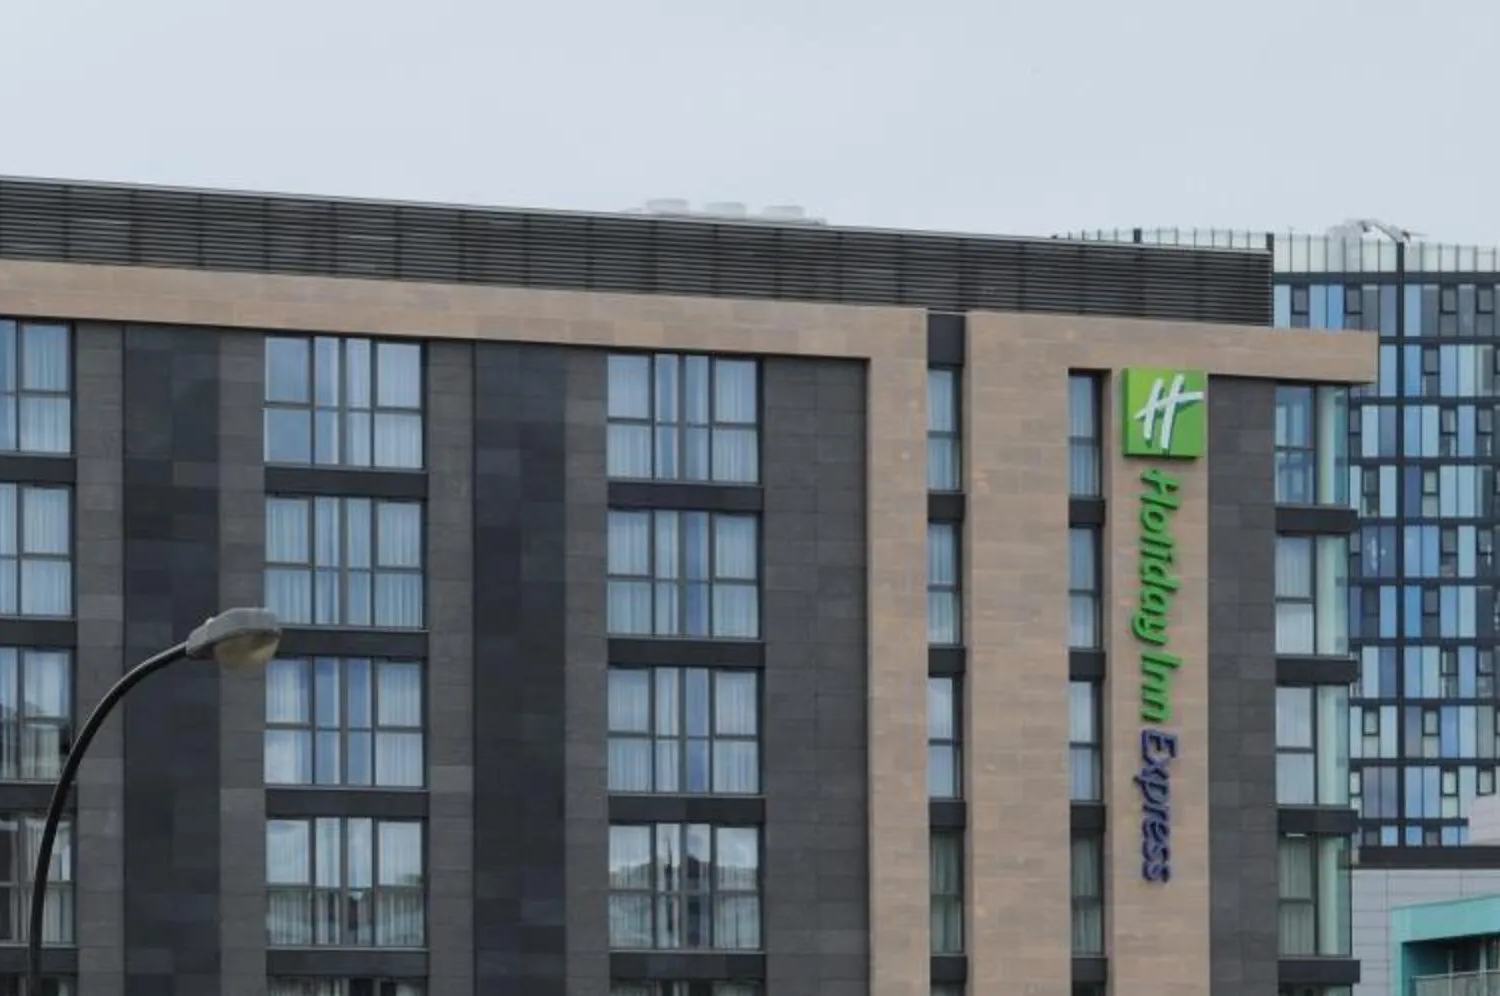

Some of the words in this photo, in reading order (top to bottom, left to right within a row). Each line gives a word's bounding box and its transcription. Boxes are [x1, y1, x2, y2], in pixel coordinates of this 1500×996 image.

[1131, 469, 1180, 647] Holiday
[1140, 653, 1181, 724] Inn
[1133, 730, 1178, 883] Express
